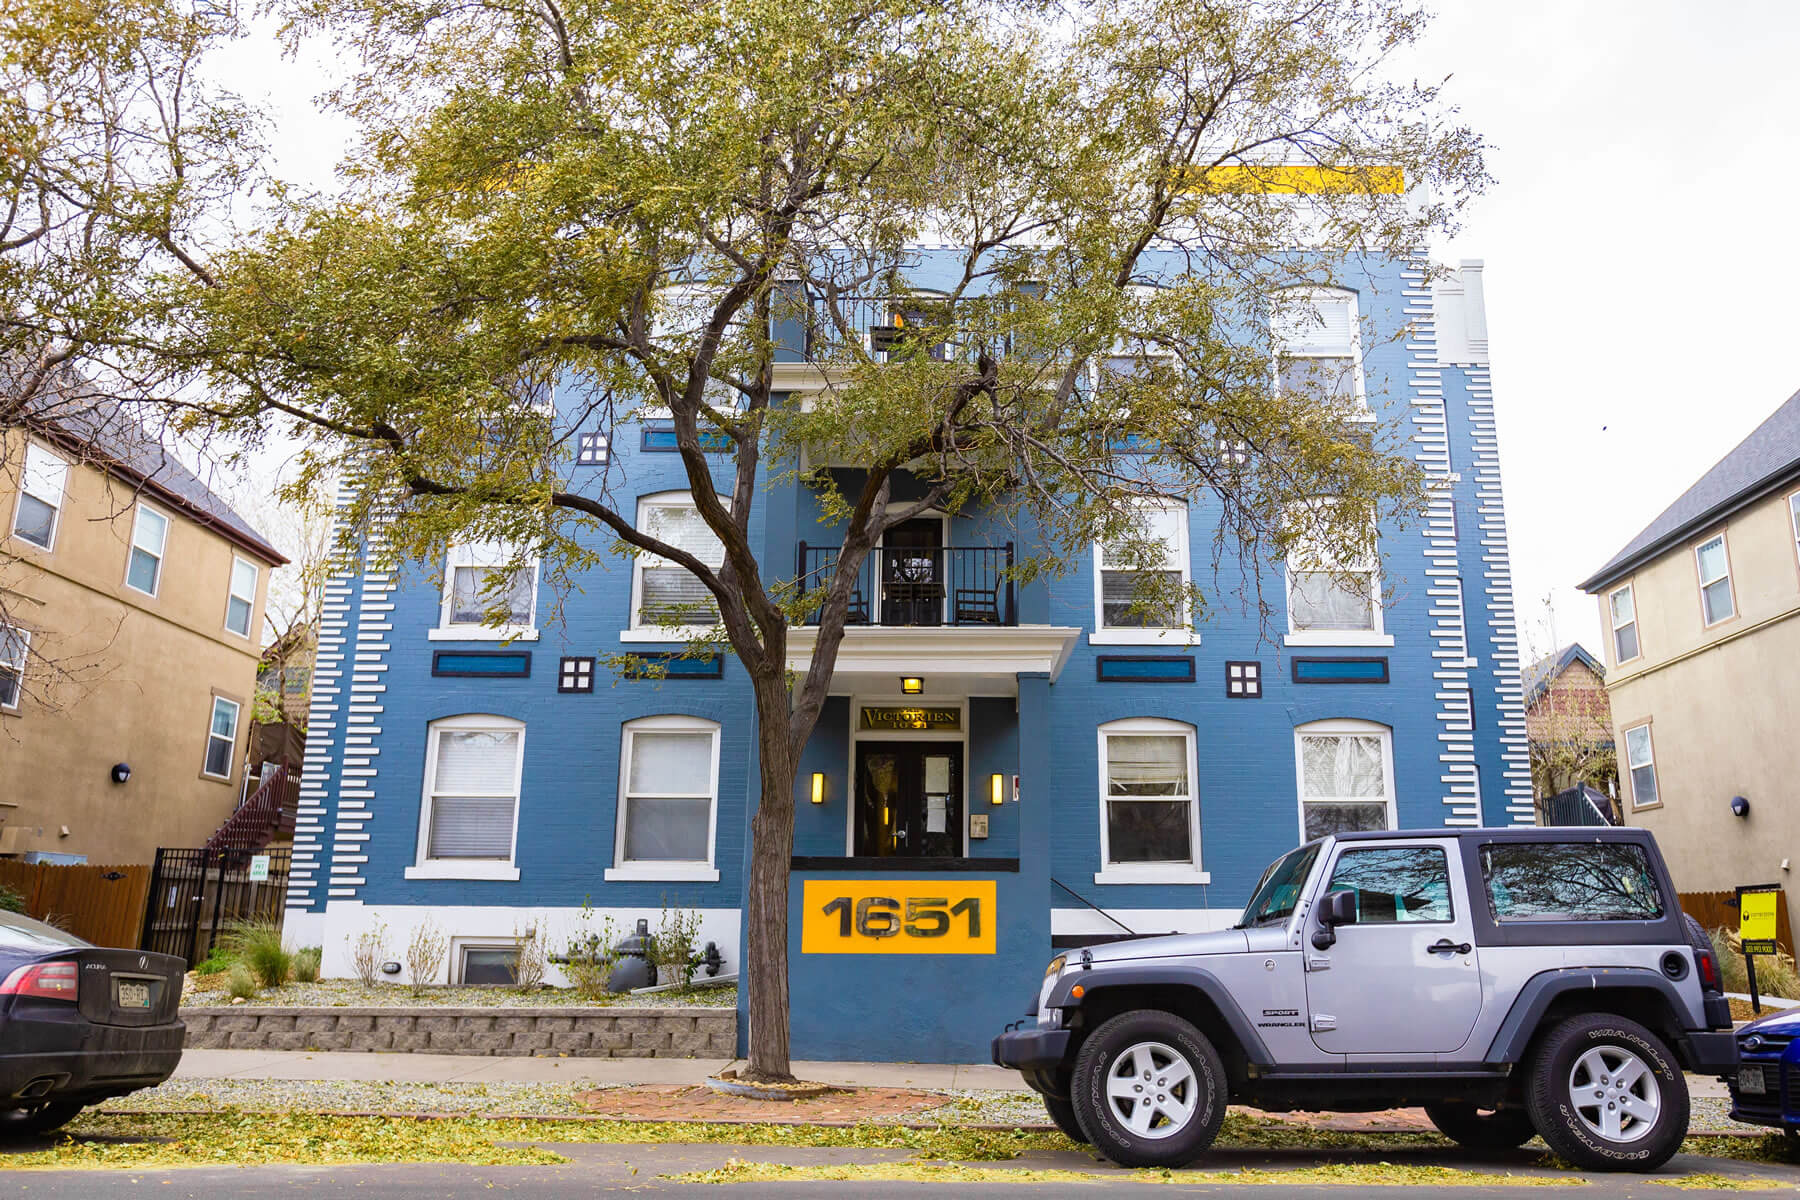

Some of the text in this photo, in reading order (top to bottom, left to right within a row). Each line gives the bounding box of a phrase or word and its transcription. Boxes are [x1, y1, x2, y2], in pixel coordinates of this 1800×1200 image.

[822, 897, 982, 938] 1651
[1263, 1009, 1299, 1017] SPORT
[1588, 1028, 1674, 1082] WRANGLER
